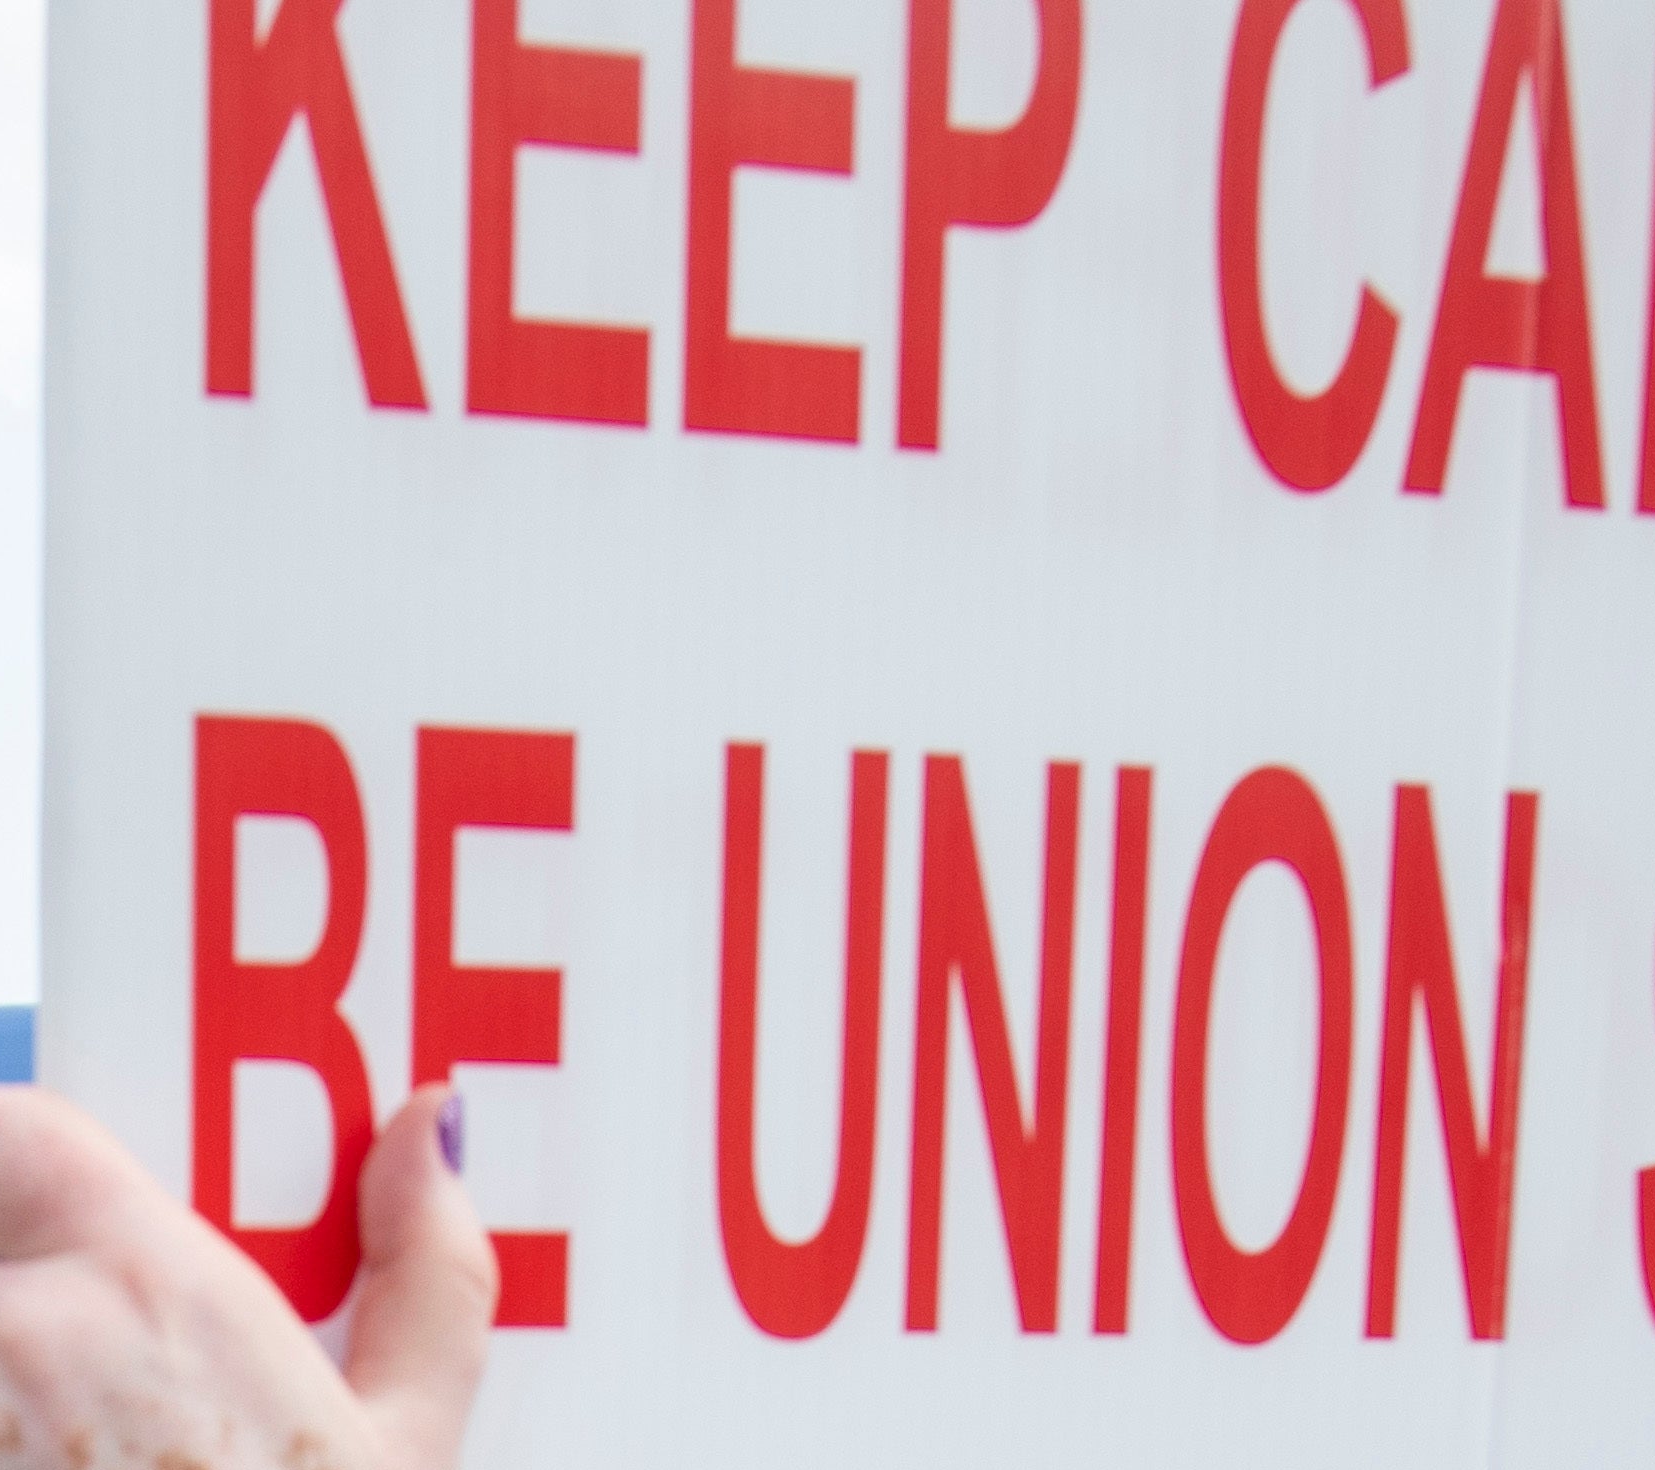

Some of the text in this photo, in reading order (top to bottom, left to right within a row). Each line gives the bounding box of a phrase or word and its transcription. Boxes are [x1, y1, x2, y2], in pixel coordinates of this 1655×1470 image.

[204, 0, 1083, 452] KEEP
[190, 714, 577, 1331] BE
[715, 742, 1539, 1347] UNION
